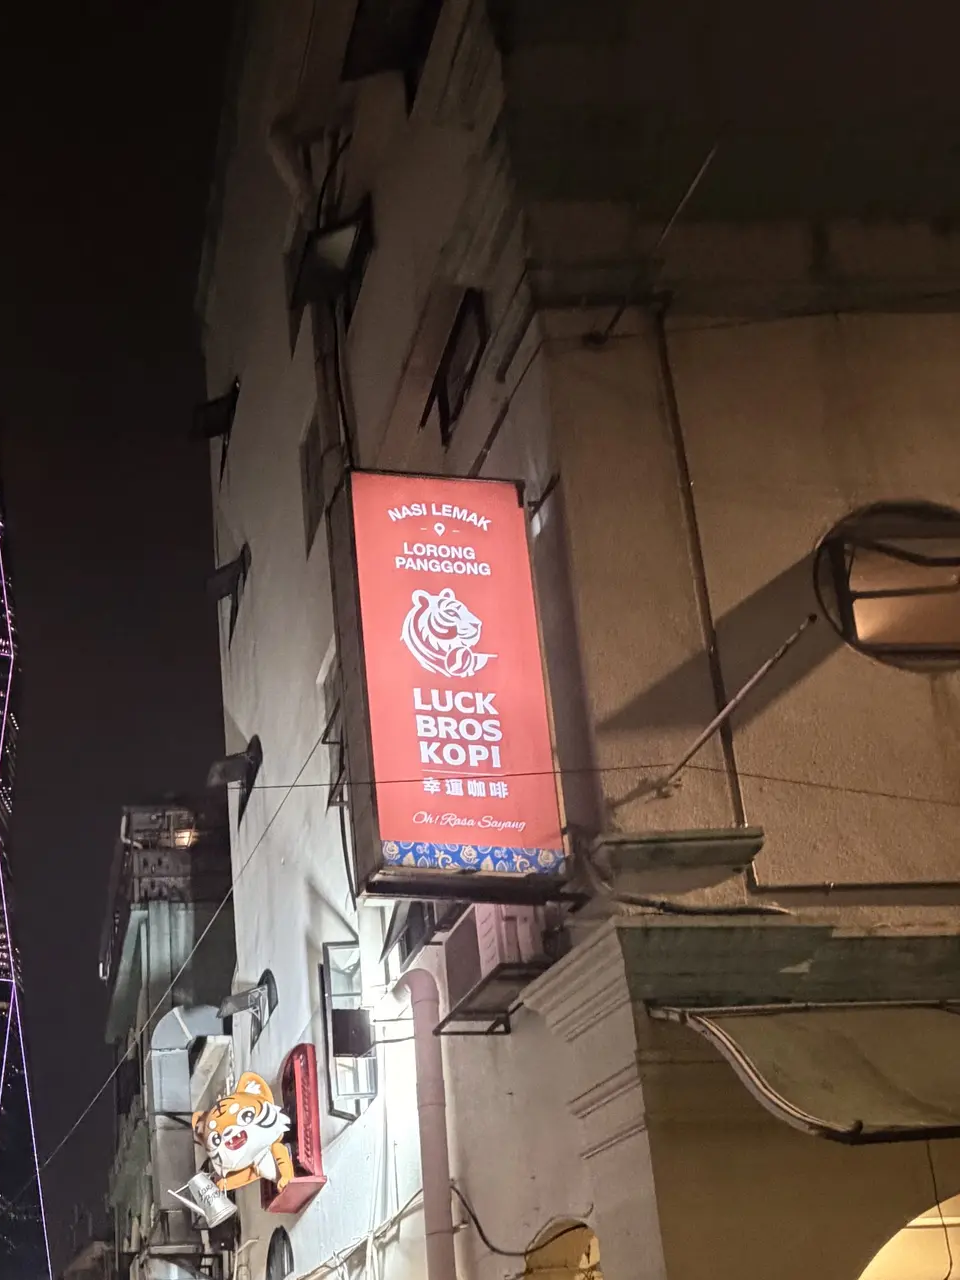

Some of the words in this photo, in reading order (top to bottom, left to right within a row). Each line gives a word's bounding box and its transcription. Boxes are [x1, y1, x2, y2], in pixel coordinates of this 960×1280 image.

[387, 503, 427, 522] NASI
[431, 503, 492, 531] LEMAK
[403, 541, 476, 560] LORONG
[395, 556, 492, 576] PANGGONG
[413, 688, 500, 715] LUCK
[415, 714, 503, 742] BROS
[419, 741, 501, 768] KOPI
[422, 777, 509, 798] 幸運咖啡
[412, 811, 439, 824] Oh!
[440, 812, 476, 828] Rasa
[477, 815, 527, 832] Sayang
